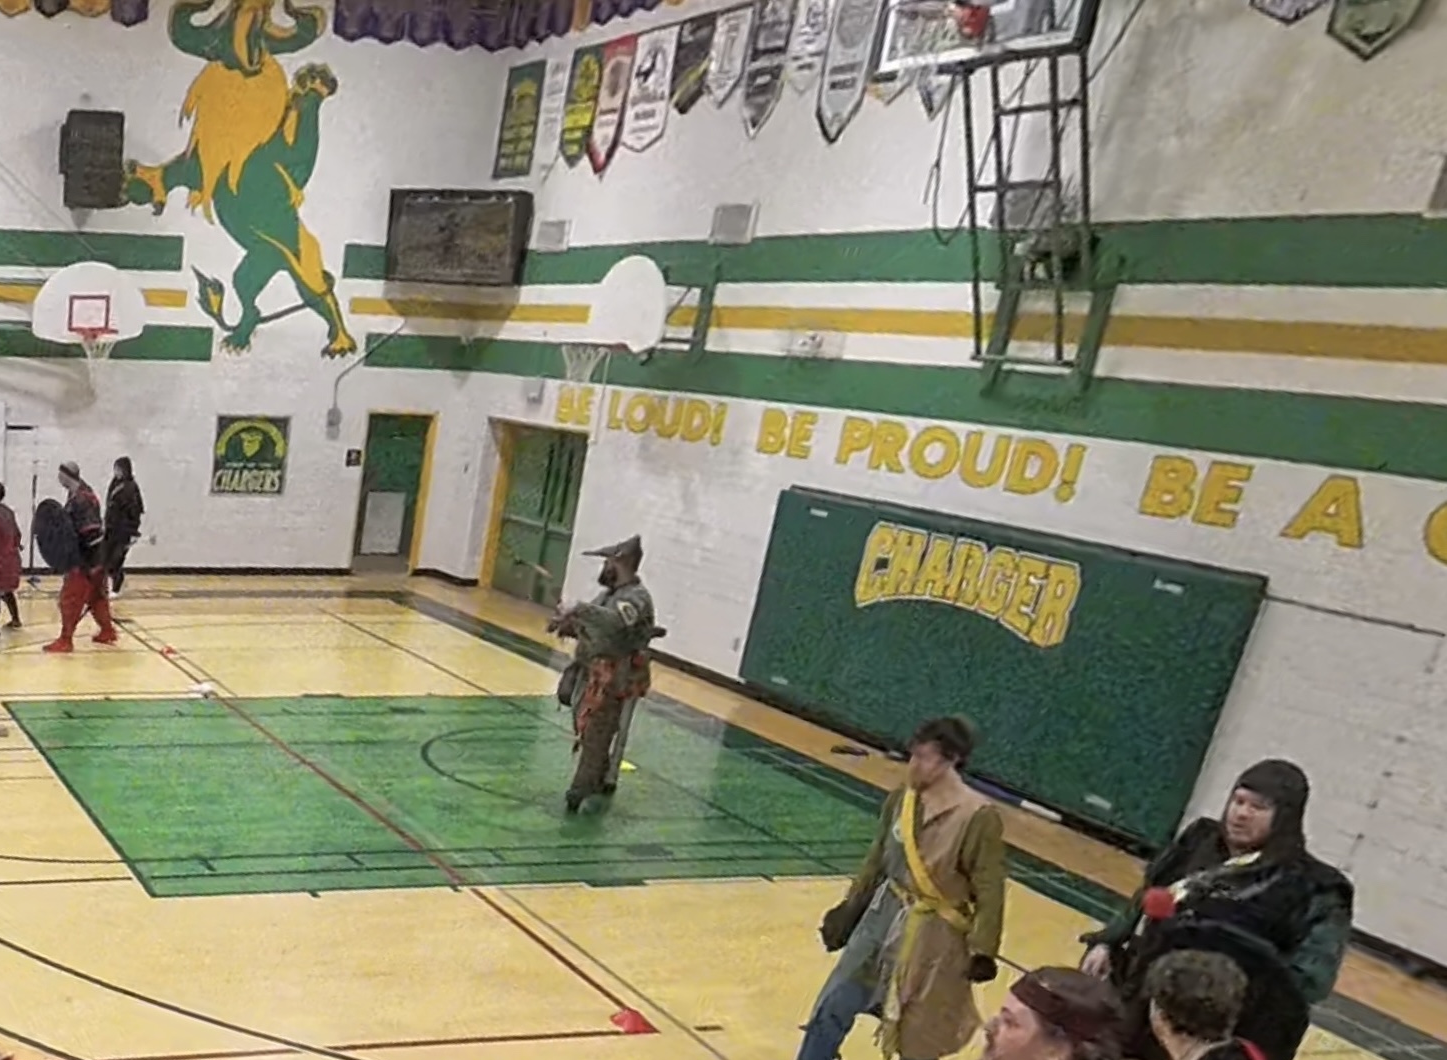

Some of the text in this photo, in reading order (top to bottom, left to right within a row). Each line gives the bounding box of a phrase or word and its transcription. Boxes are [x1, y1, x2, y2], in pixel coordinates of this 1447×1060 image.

[556, 385, 595, 425] BE
[607, 389, 729, 447] LOUD!
[756, 406, 818, 460] BE
[836, 415, 1087, 504] PROUD!
[1139, 454, 1256, 530] BE
[1280, 473, 1365, 549] A
[855, 520, 1082, 649] CHARGER
